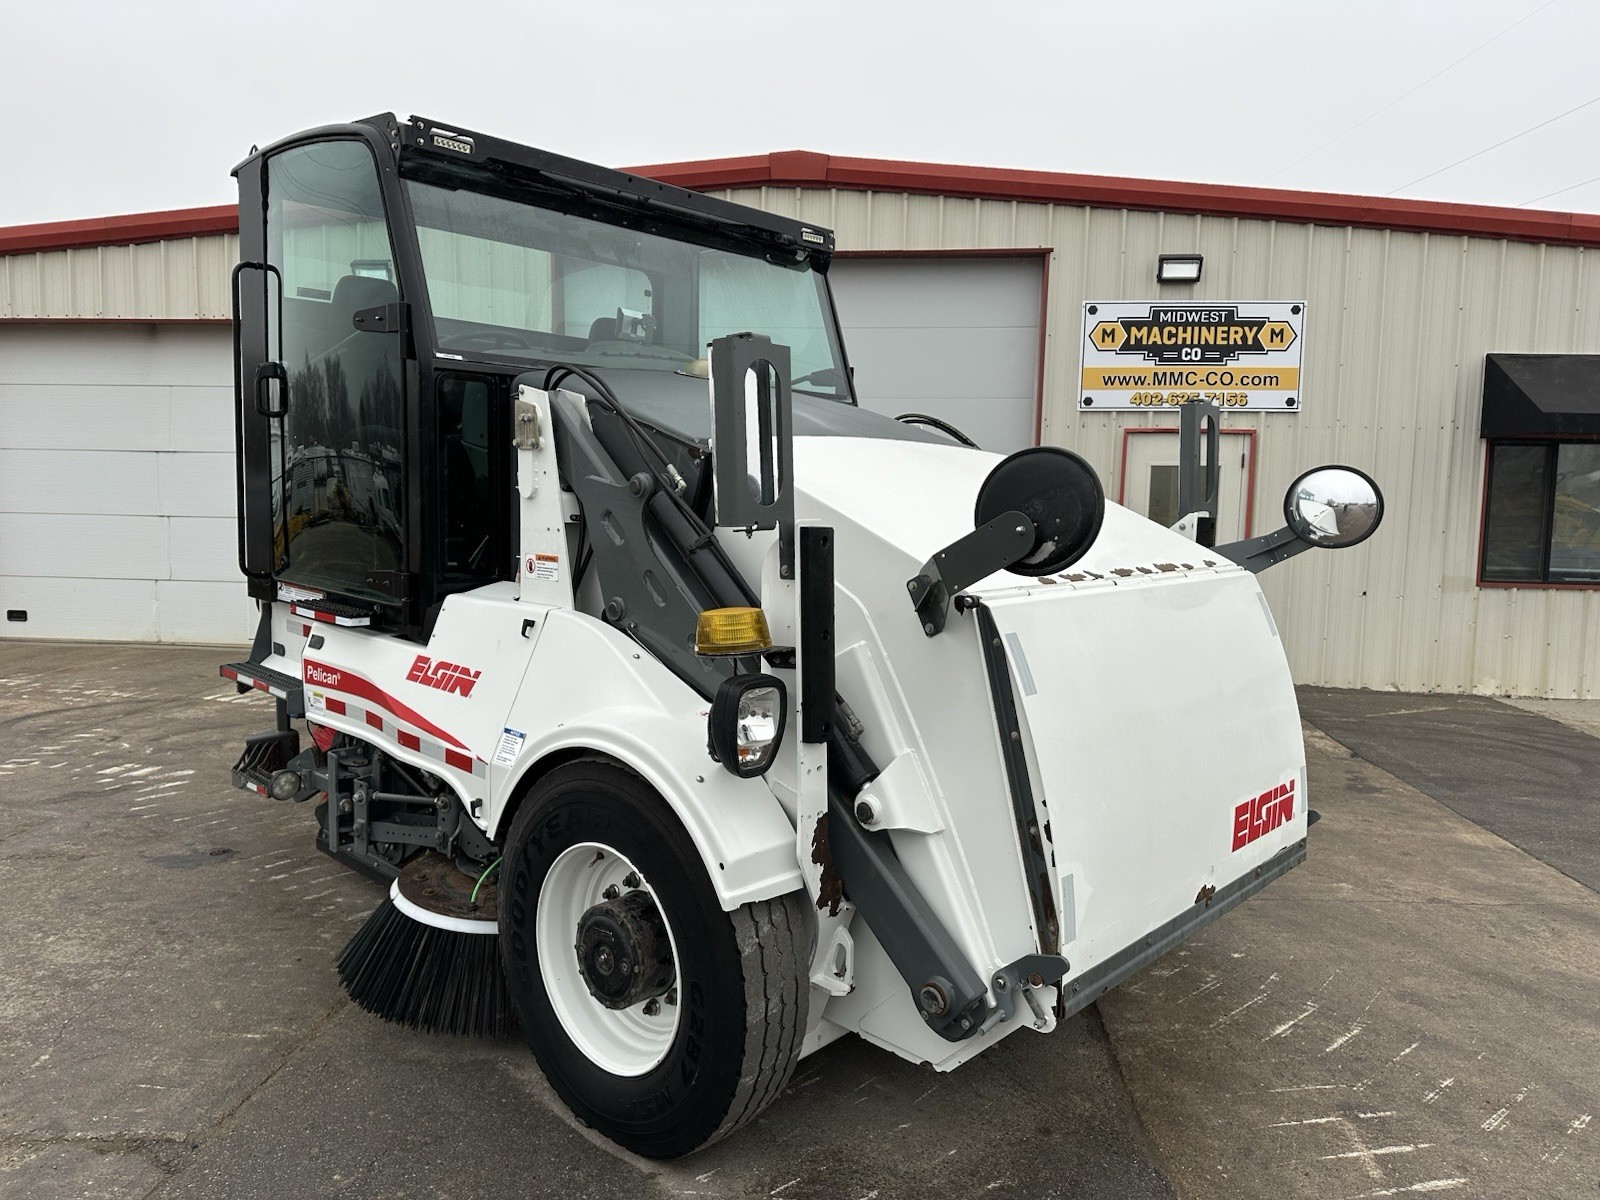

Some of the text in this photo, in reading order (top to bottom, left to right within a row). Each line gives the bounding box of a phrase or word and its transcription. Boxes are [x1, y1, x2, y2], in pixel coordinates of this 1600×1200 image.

[1159, 311, 1228, 323] MIDWEST
[1101, 327, 1116, 344] M
[1129, 326, 1258, 345] MACHINERY
[1269, 327, 1285, 344] M
[1181, 347, 1202, 361] CO
[1102, 371, 1279, 386] www.MMC-CO.com
[1130, 392, 1248, 406] 402-6257156
[406, 654, 482, 698] ELGIN
[1231, 779, 1295, 853] ELGIN
